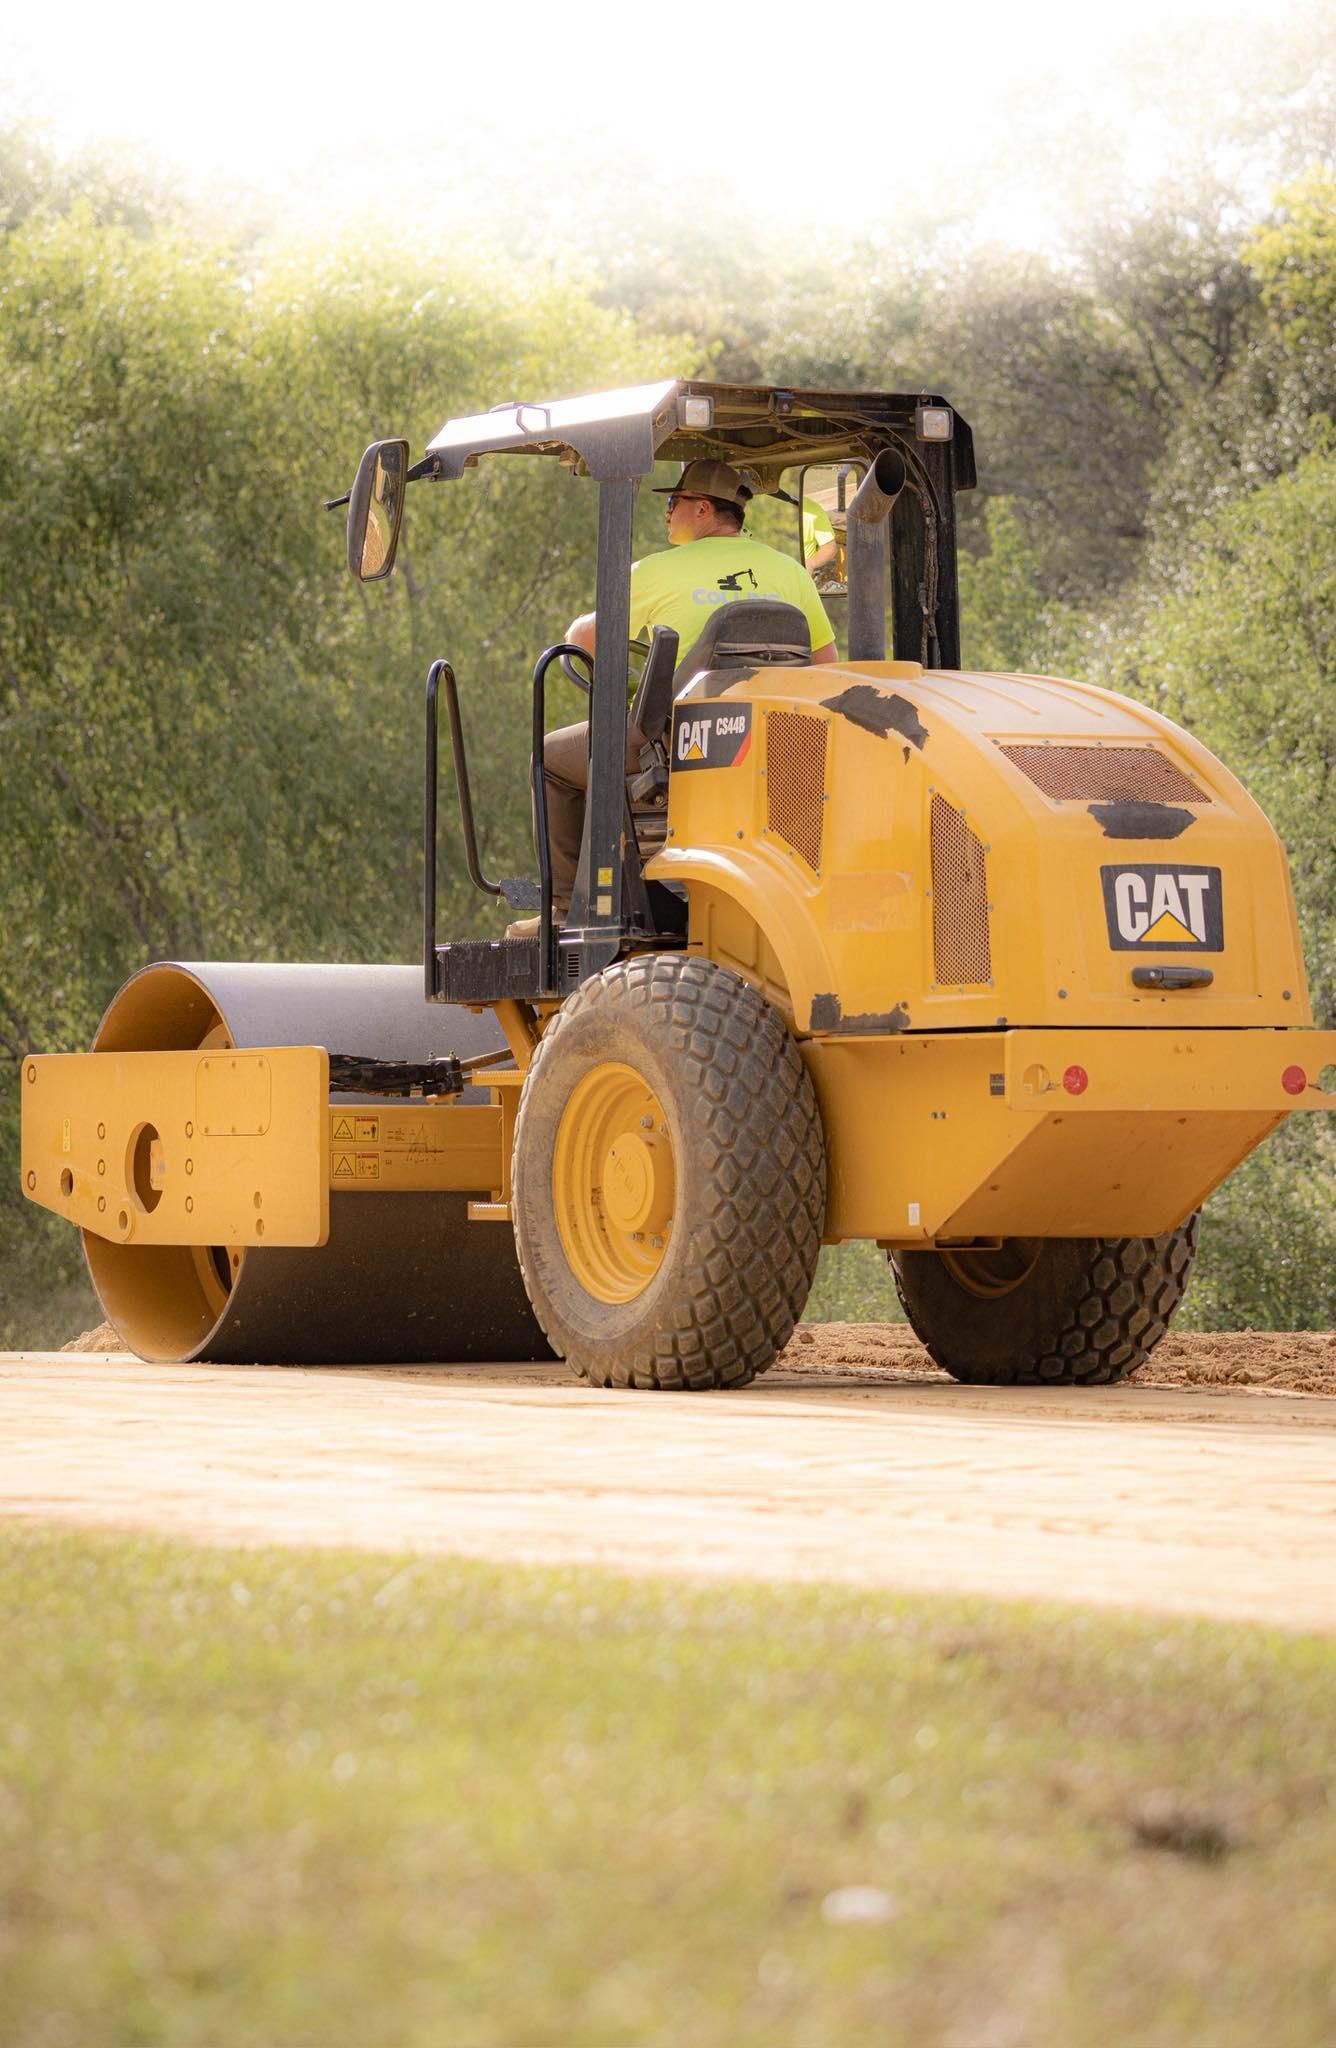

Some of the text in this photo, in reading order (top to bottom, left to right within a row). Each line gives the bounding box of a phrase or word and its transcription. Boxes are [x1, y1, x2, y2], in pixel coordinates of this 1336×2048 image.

[678, 716, 746, 761] CAT CS44B
[1115, 872, 1210, 942] CAT
